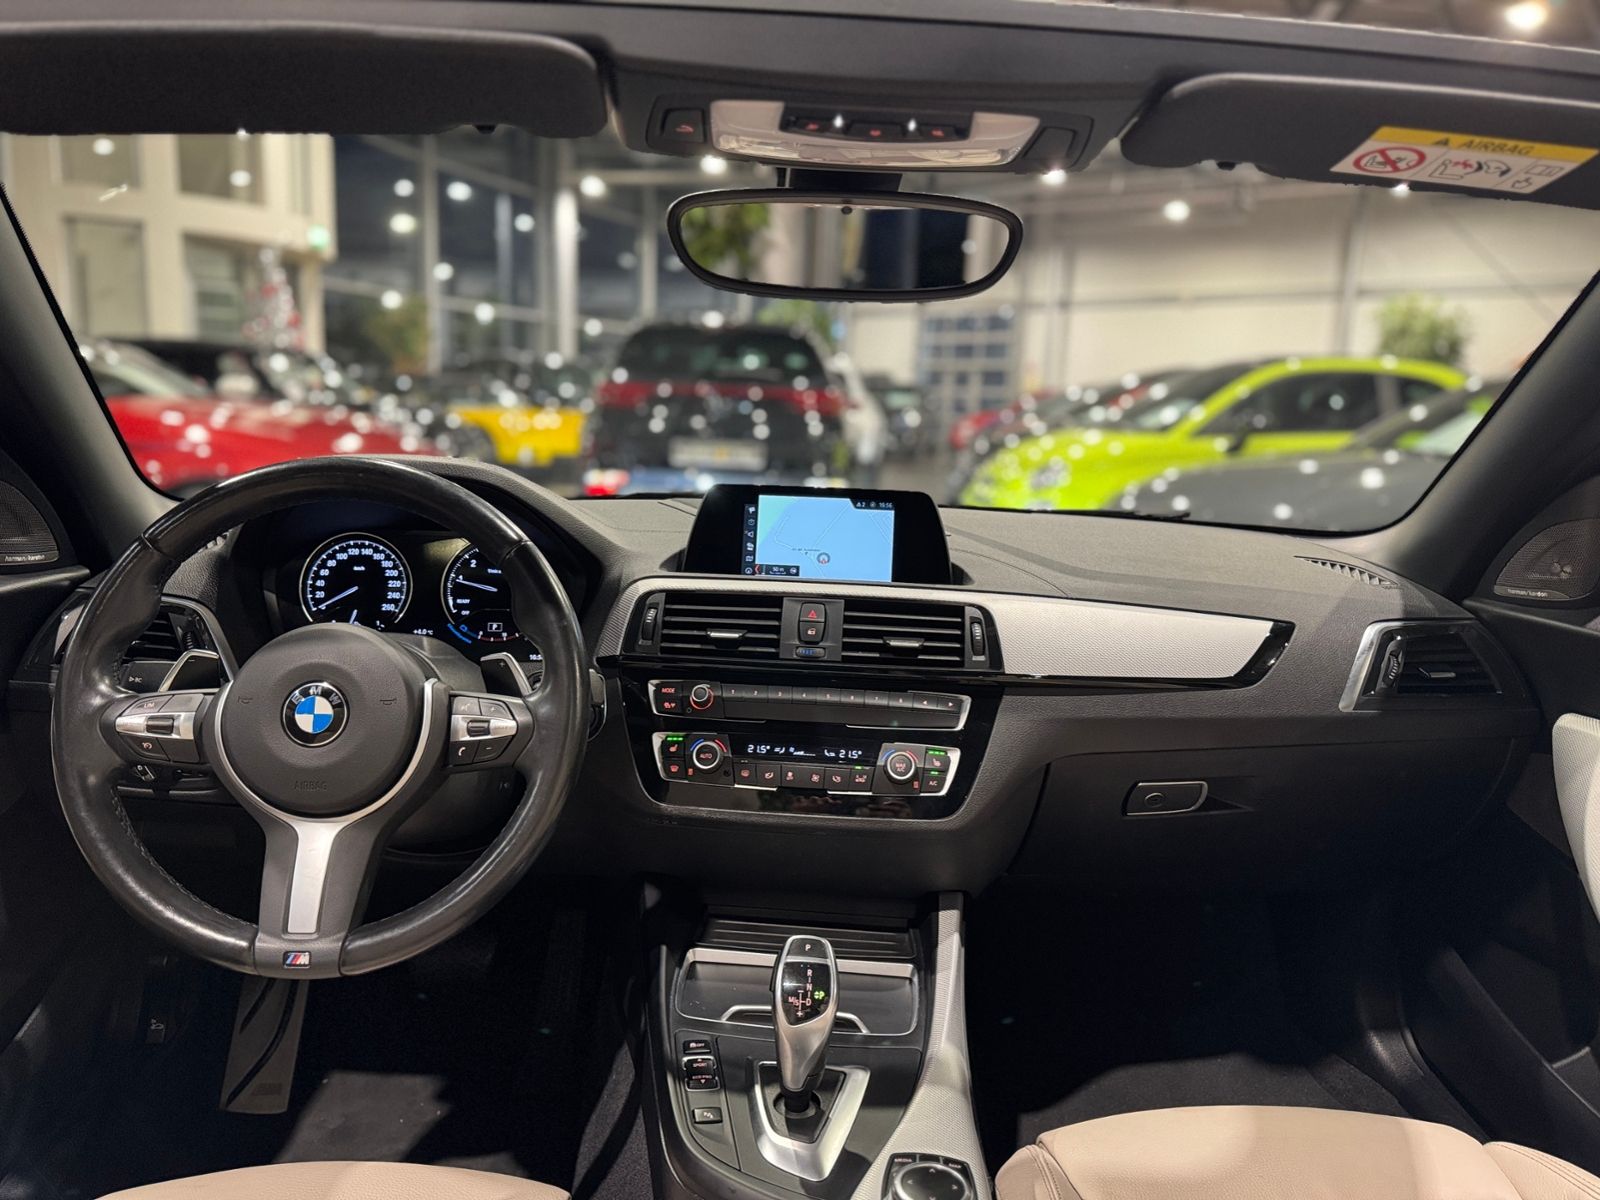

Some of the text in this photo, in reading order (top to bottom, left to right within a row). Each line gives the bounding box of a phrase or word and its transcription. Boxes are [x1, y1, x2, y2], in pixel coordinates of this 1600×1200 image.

[1460, 138, 1535, 157] AIRBAG
[470, 559, 477, 568] 2
[381, 603, 395, 611] 260
[291, 685, 341, 705] BMW
[807, 969, 813, 977] R
[806, 983, 812, 991] N
[806, 998, 812, 1006] D
